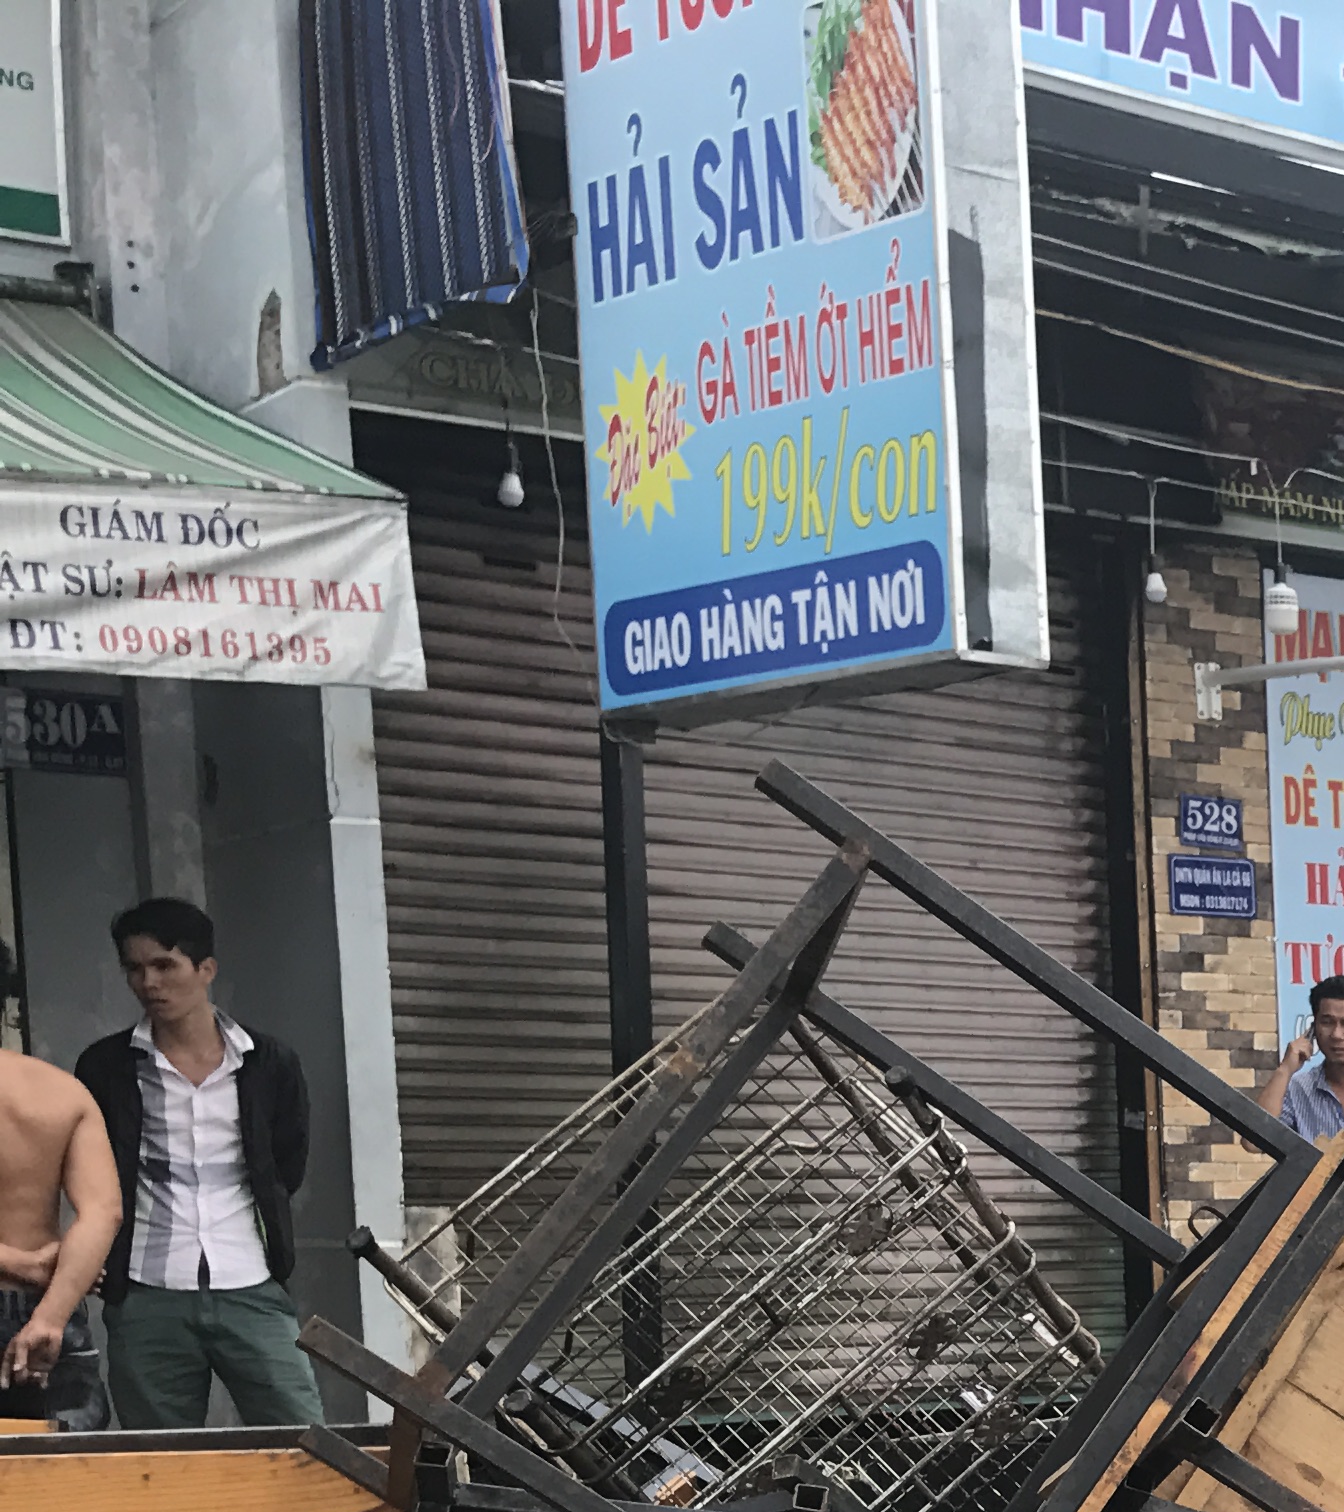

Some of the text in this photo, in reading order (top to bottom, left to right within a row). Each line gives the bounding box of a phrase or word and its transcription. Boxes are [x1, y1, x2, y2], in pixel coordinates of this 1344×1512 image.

[588, 73, 804, 302] HẢI SẢN
[696, 312, 741, 425] GÀ
[856, 239, 934, 385] HIỂM
[715, 405, 938, 557] 199k/con
[60, 498, 262, 550] GIÁM ĐỐC
[135, 560, 219, 604] LÂM
[230, 574, 300, 617] THỊ
[311, 579, 386, 614] MAI
[624, 559, 926, 675] GIAO HÀNG TẬN NƠI
[8, 619, 332, 667] ĐT: 0908161395
[1187, 800, 1238, 834] 528
[1283, 764, 1320, 828] DÊ
